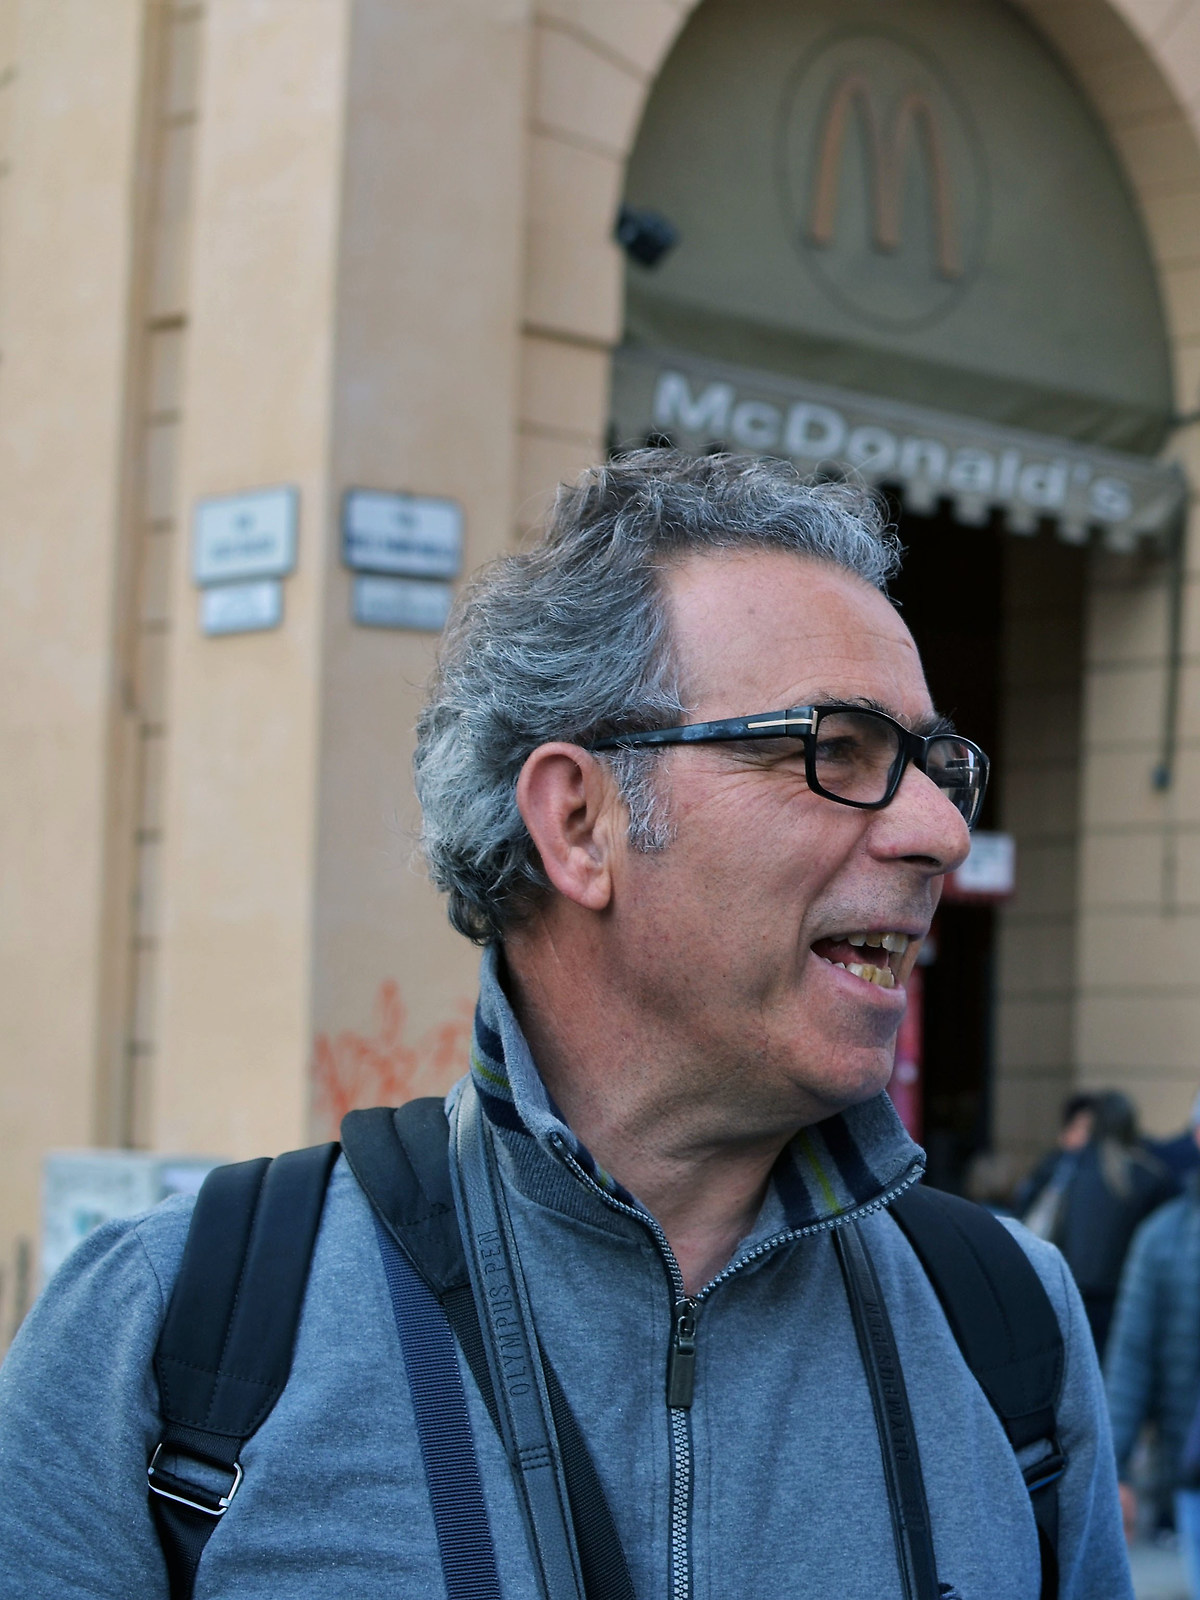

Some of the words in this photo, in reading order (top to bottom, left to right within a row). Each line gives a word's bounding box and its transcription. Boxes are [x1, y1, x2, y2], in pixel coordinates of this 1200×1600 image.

[653, 370, 1134, 523] McDonald's
[477, 1229, 506, 1275] PEN
[489, 1284, 531, 1397] OLYMPUS
[878, 1355, 910, 1461] OLYMPUS
